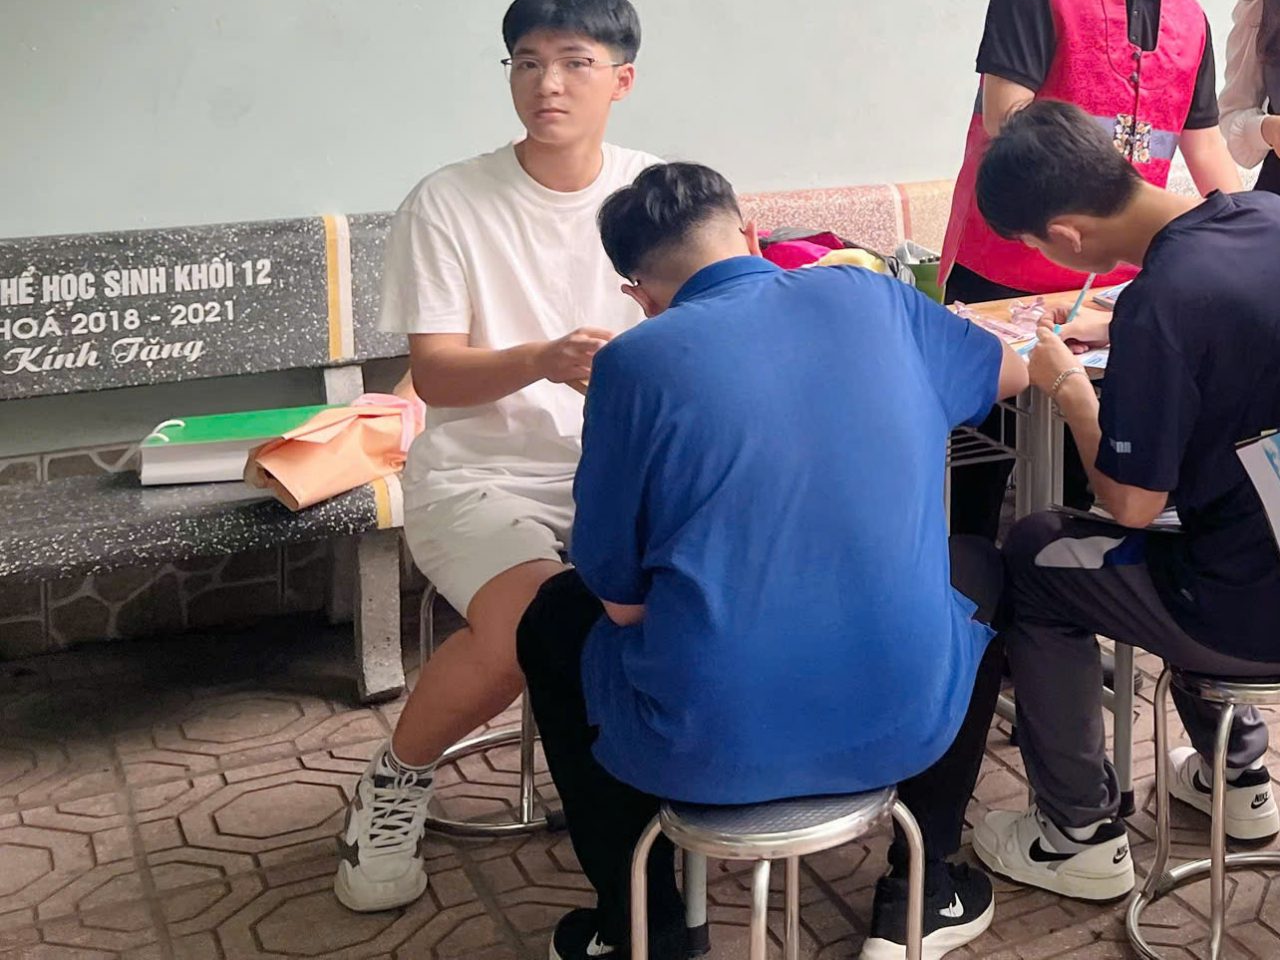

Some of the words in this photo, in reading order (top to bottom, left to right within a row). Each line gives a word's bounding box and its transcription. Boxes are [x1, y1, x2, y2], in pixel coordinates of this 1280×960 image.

[0, 266, 35, 306] HỂ
[42, 272, 96, 308] HỌC
[104, 267, 167, 298] SINH
[174, 252, 234, 291] KHỐI
[241, 258, 272, 286] 12
[0, 308, 62, 340] HOÁ
[71, 309, 140, 335] 2018
[171, 300, 234, 326] 2021
[1, 342, 101, 374] Kính
[111, 337, 206, 368] Tặng
